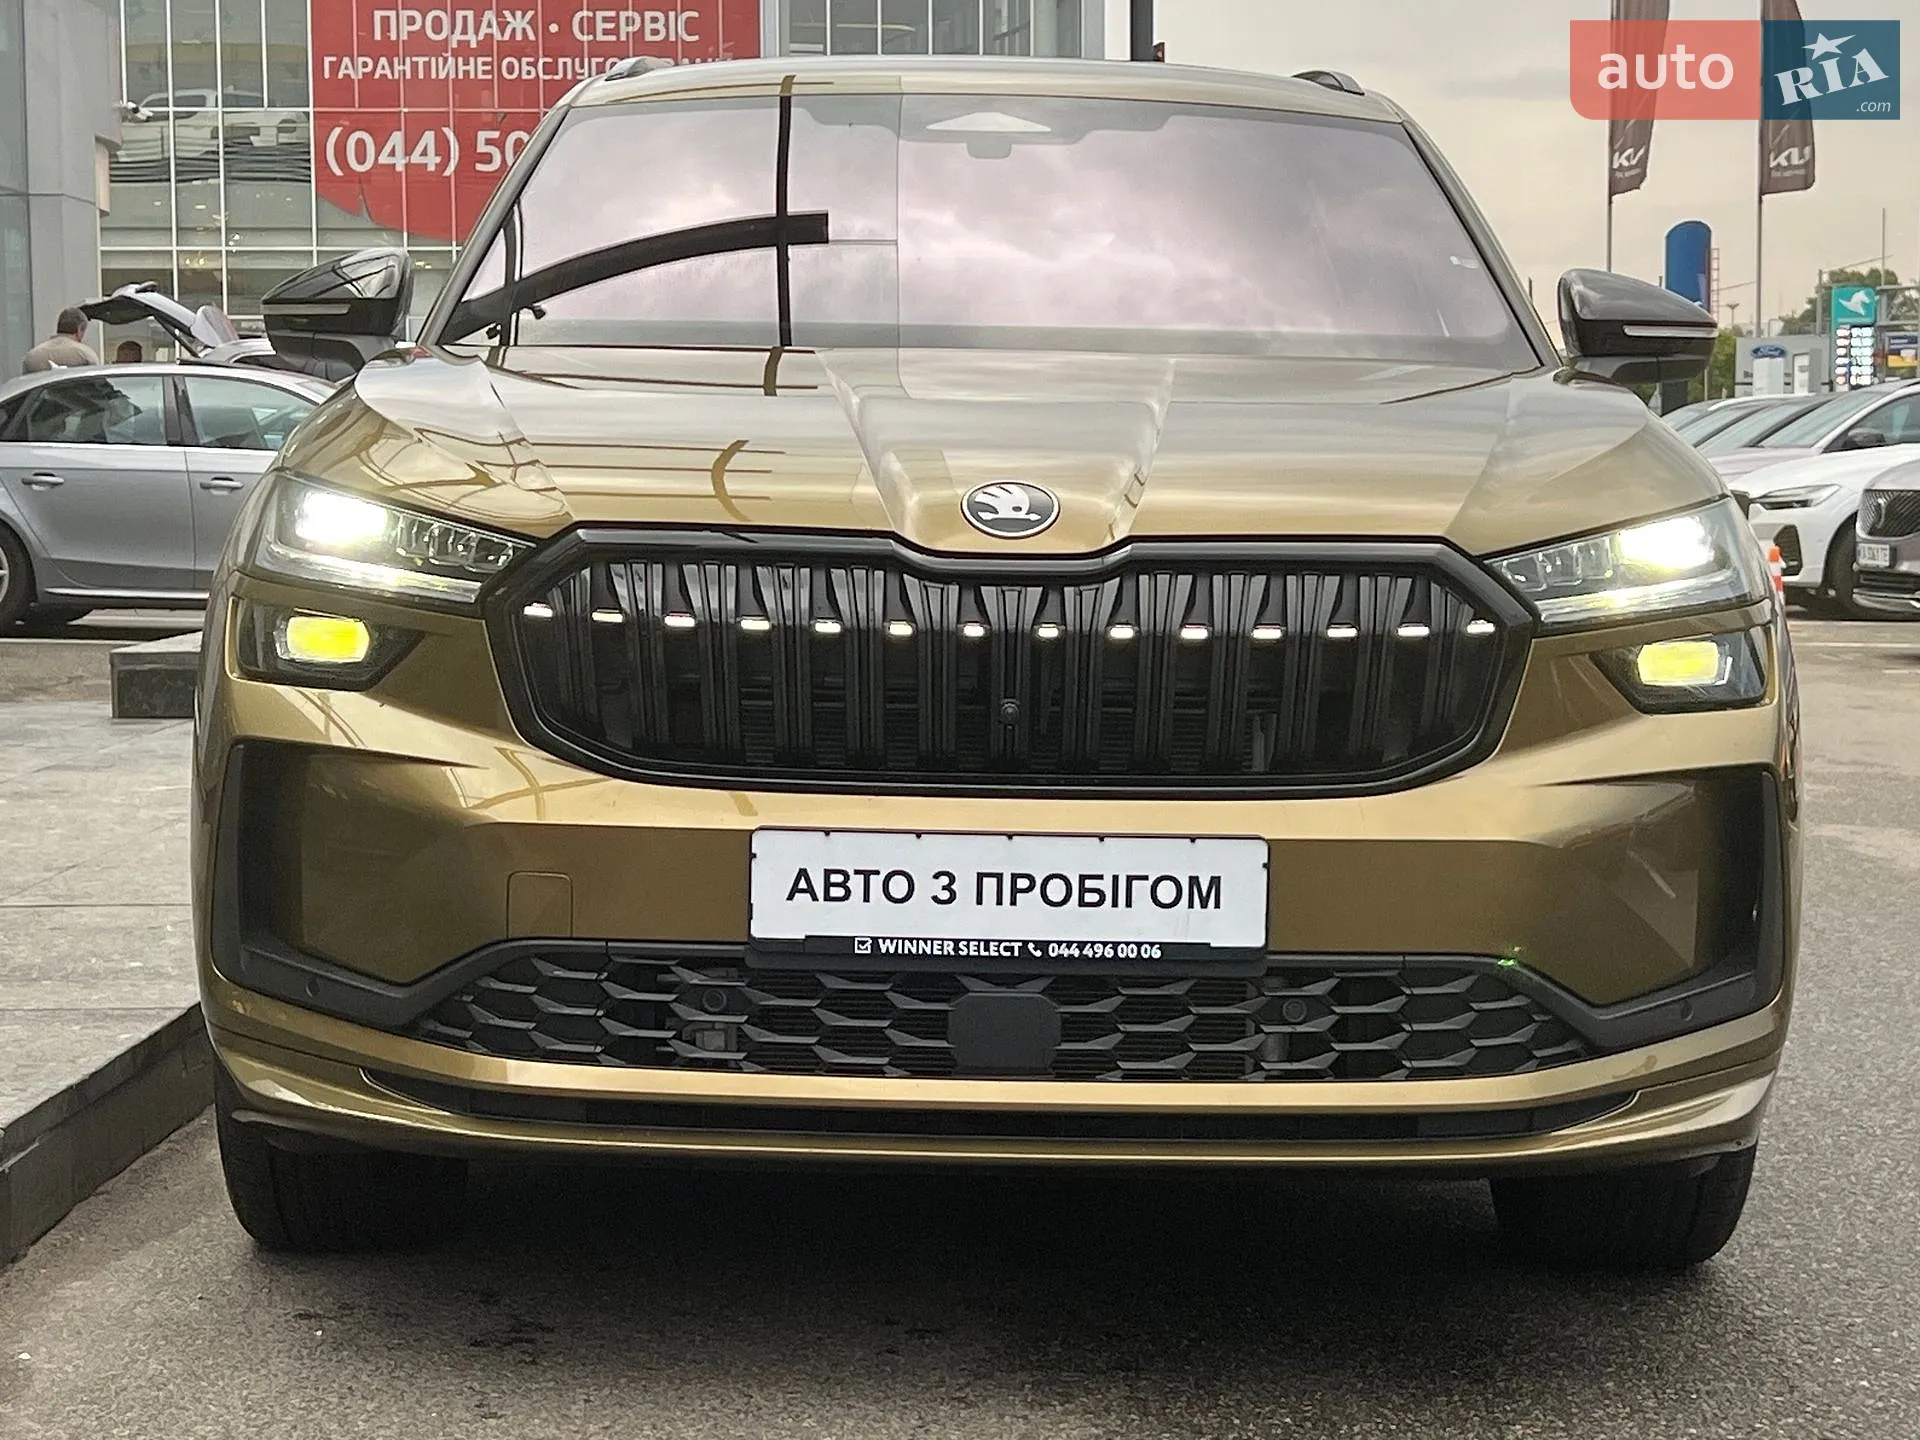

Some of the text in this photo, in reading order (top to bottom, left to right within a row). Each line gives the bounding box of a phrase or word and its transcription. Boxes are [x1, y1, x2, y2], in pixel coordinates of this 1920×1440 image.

[374, 9, 701, 48] ПРОДАЖ СЕРВІС
[323, 53, 492, 81] ГАРАНТІЙНЕ
[325, 126, 459, 177] (044)
[786, 868, 916, 905] АВТО
[975, 871, 1223, 910] ПРОБІГОМ
[879, 939, 1162, 960] WINNER SELECT 044 496 00 06
